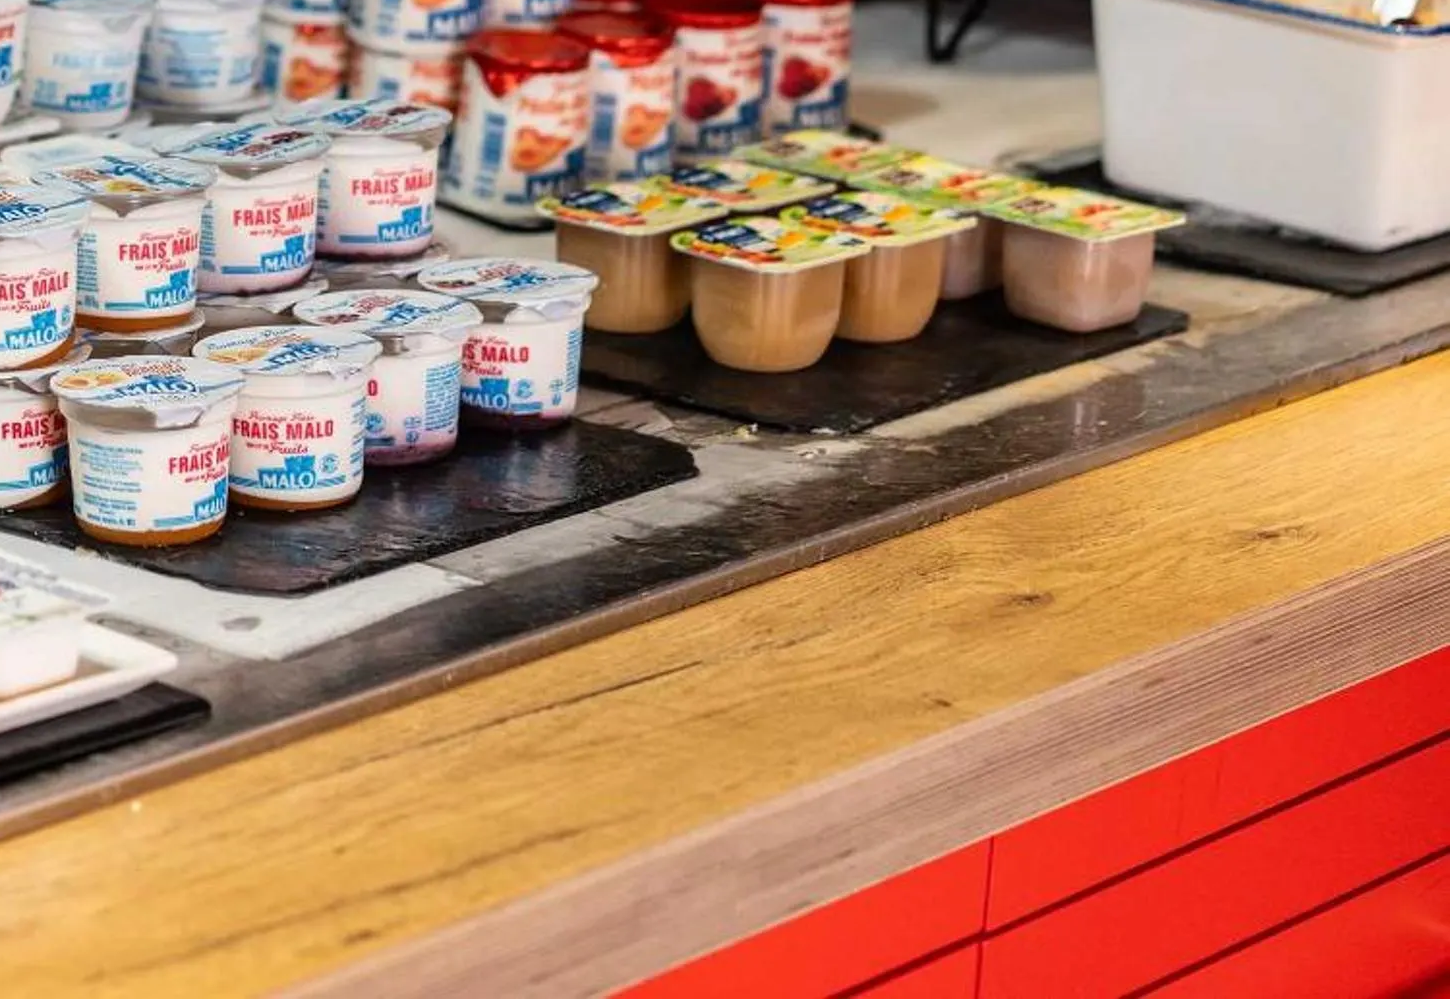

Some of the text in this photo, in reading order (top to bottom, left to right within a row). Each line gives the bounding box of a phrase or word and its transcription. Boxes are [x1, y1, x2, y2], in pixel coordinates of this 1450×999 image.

[352, 179, 398, 196] FRAIS
[233, 209, 281, 226] FRAIS
[382, 221, 420, 241] MALO
[119, 241, 166, 261] FRAIS
[264, 250, 303, 273] MALO
[151, 285, 189, 308] MALO
[9, 326, 55, 349] MALO
[481, 346, 529, 363] MALO
[461, 392, 507, 409] MALO
[1, 418, 50, 440] FRAIS
[232, 417, 334, 440] FRAIS MALO
[268, 441, 309, 455] Fruits
[168, 450, 214, 475] FRAIS
[262, 470, 314, 489] MALO
